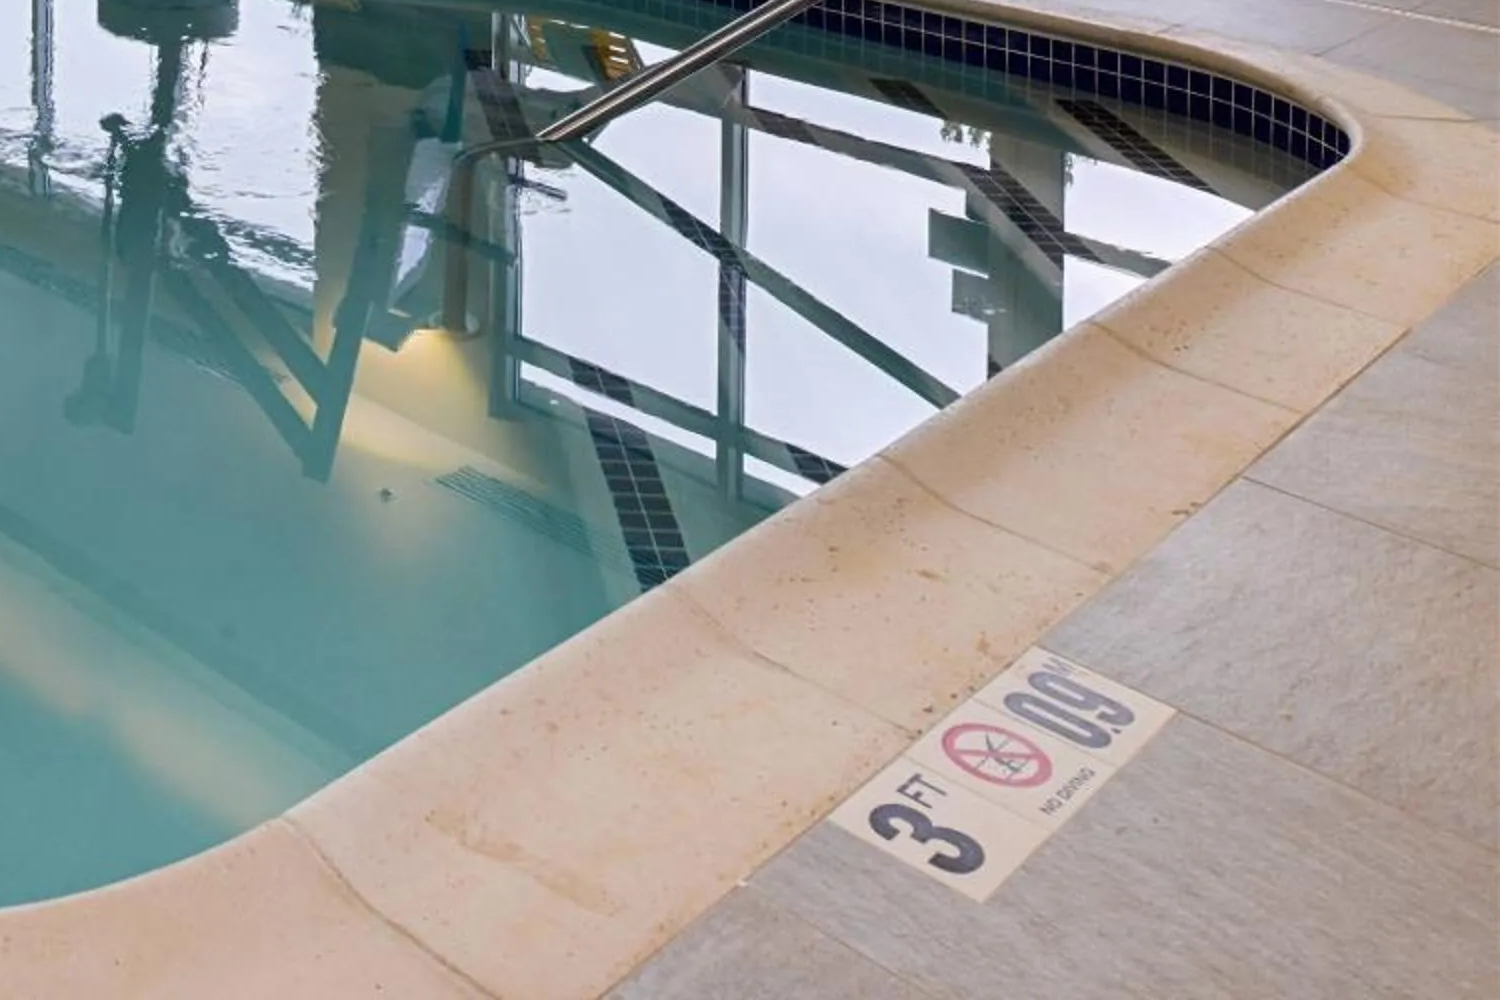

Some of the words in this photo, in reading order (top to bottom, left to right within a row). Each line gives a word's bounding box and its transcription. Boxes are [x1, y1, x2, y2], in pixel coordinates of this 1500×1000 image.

[896, 773, 947, 809] FT
[1056, 767, 1097, 800] DIVING
[868, 803, 985, 875] 3
